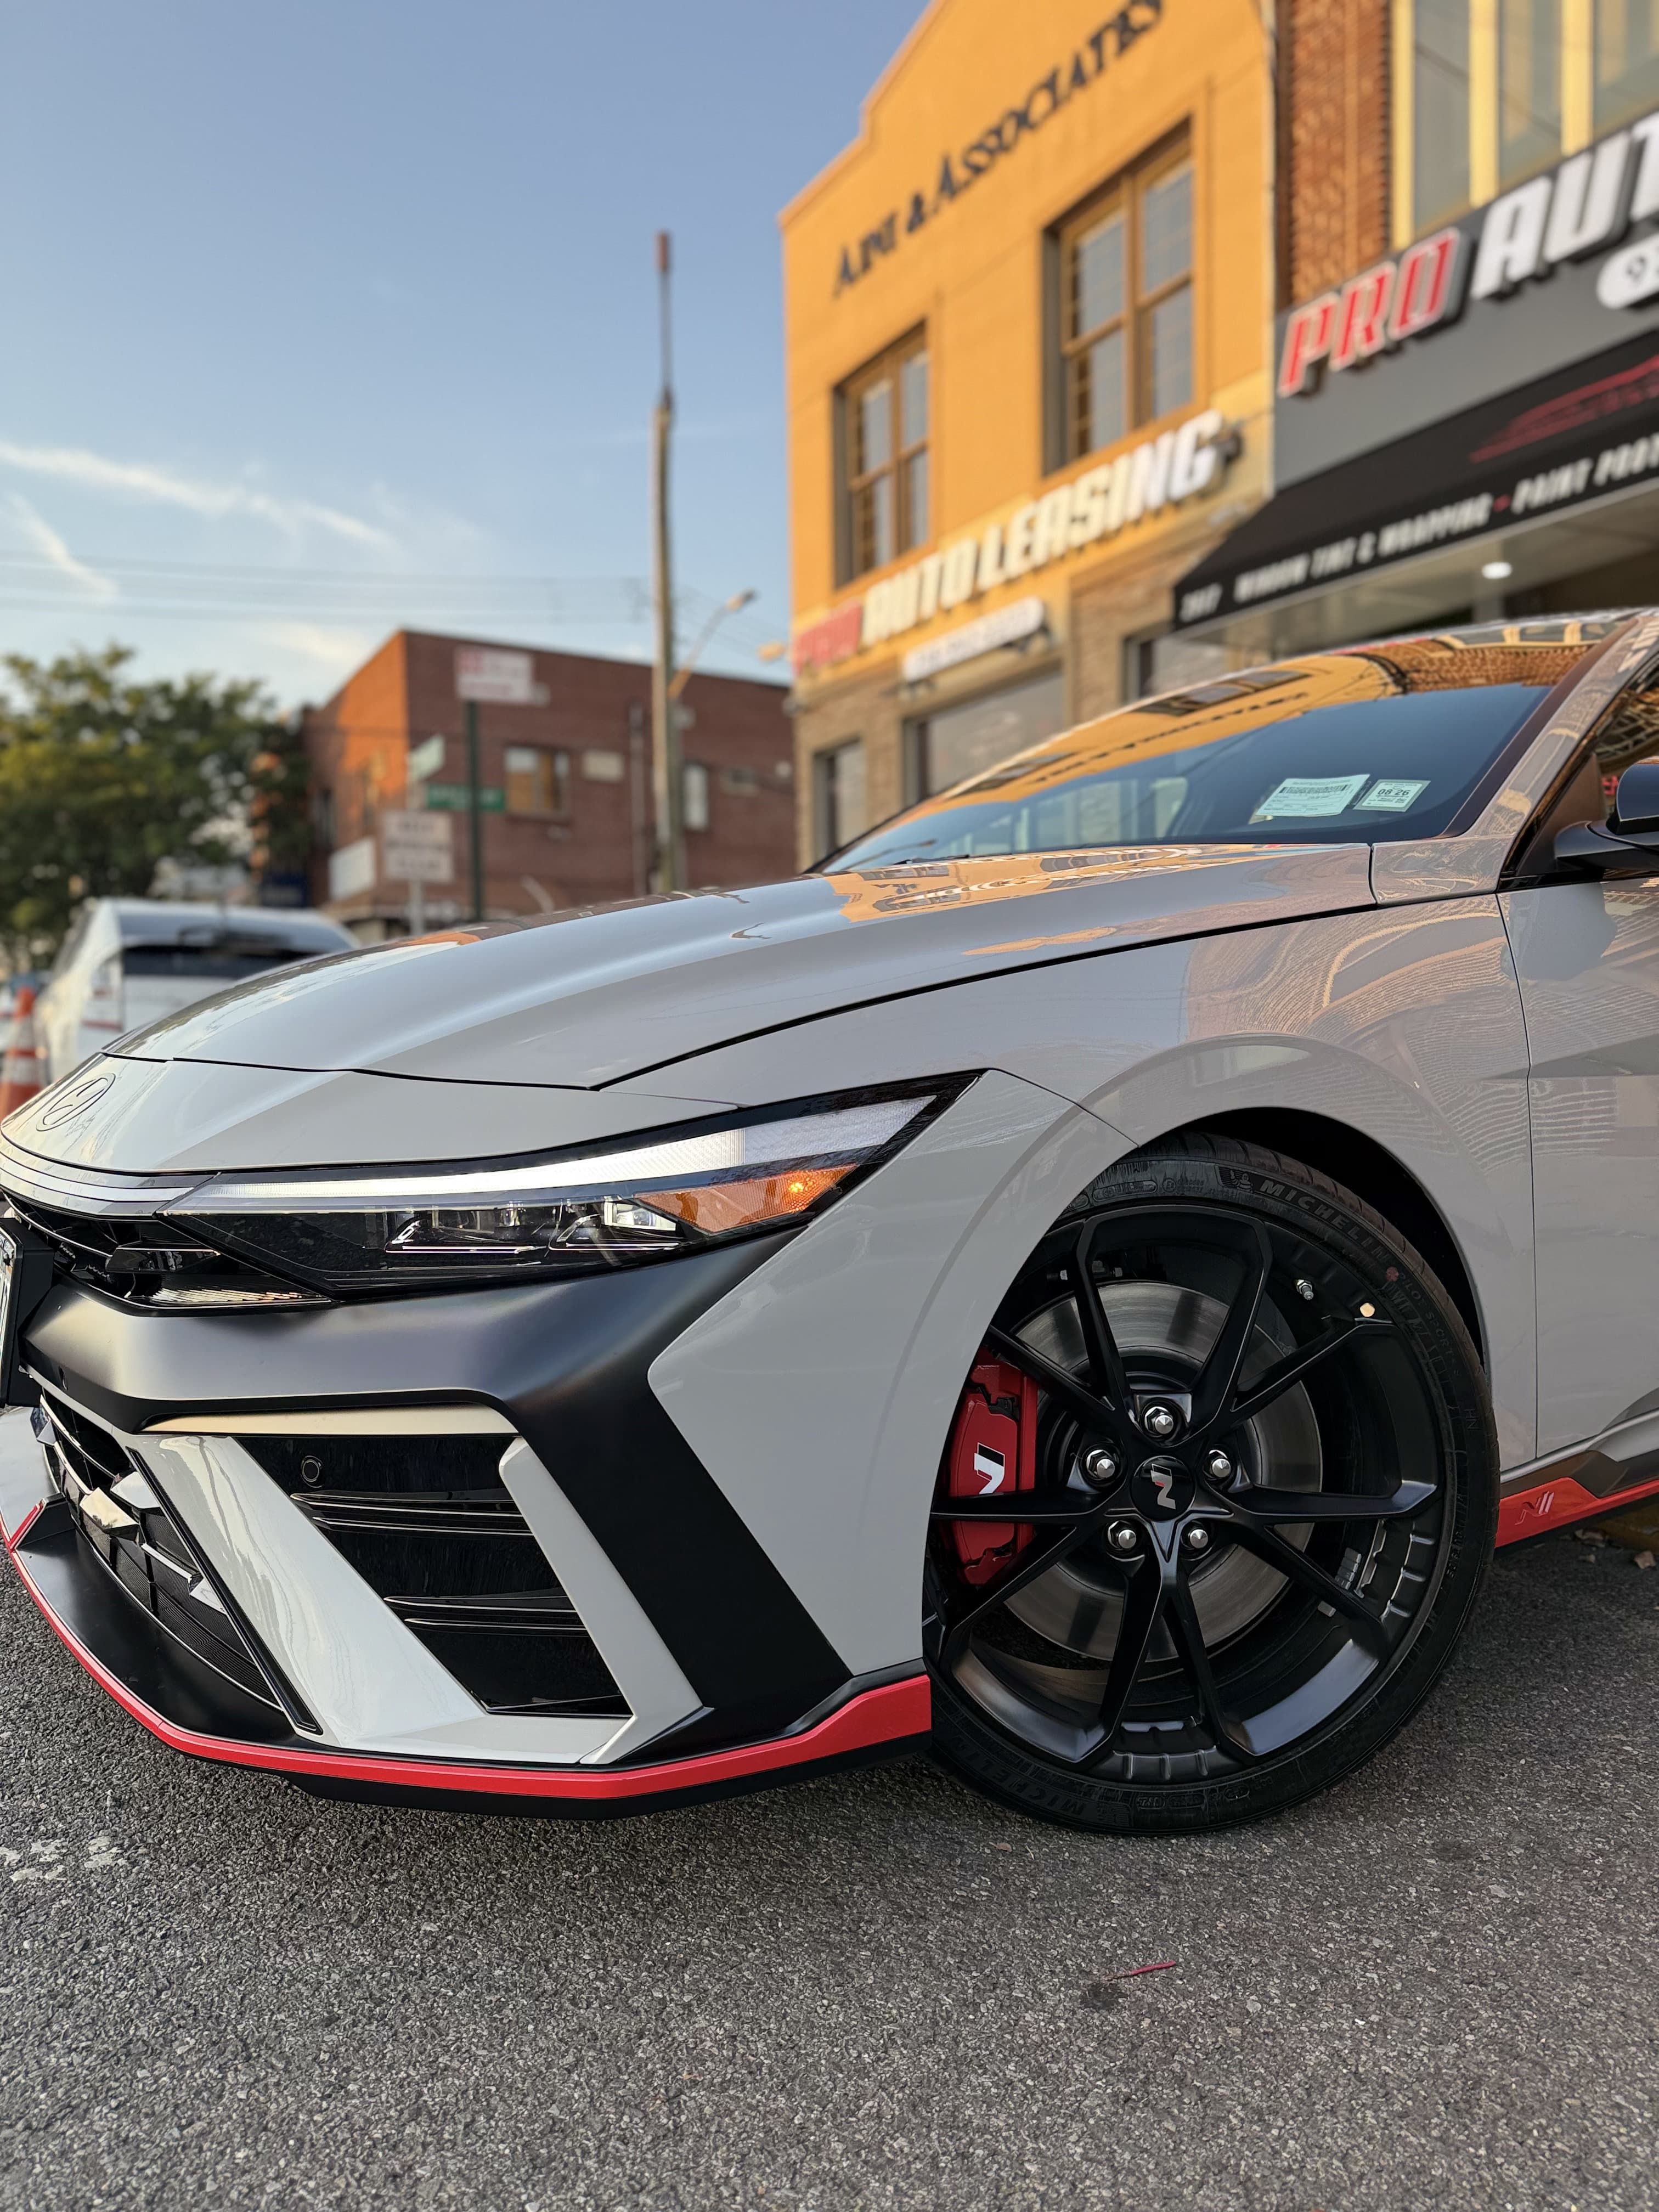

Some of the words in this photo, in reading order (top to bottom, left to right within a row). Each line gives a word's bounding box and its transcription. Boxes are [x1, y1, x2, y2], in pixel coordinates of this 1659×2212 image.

[1278, 226, 1462, 398] PRO
[978, 409, 1224, 592] LEASING
[1259, 1179, 1393, 1263] MICHELIN
